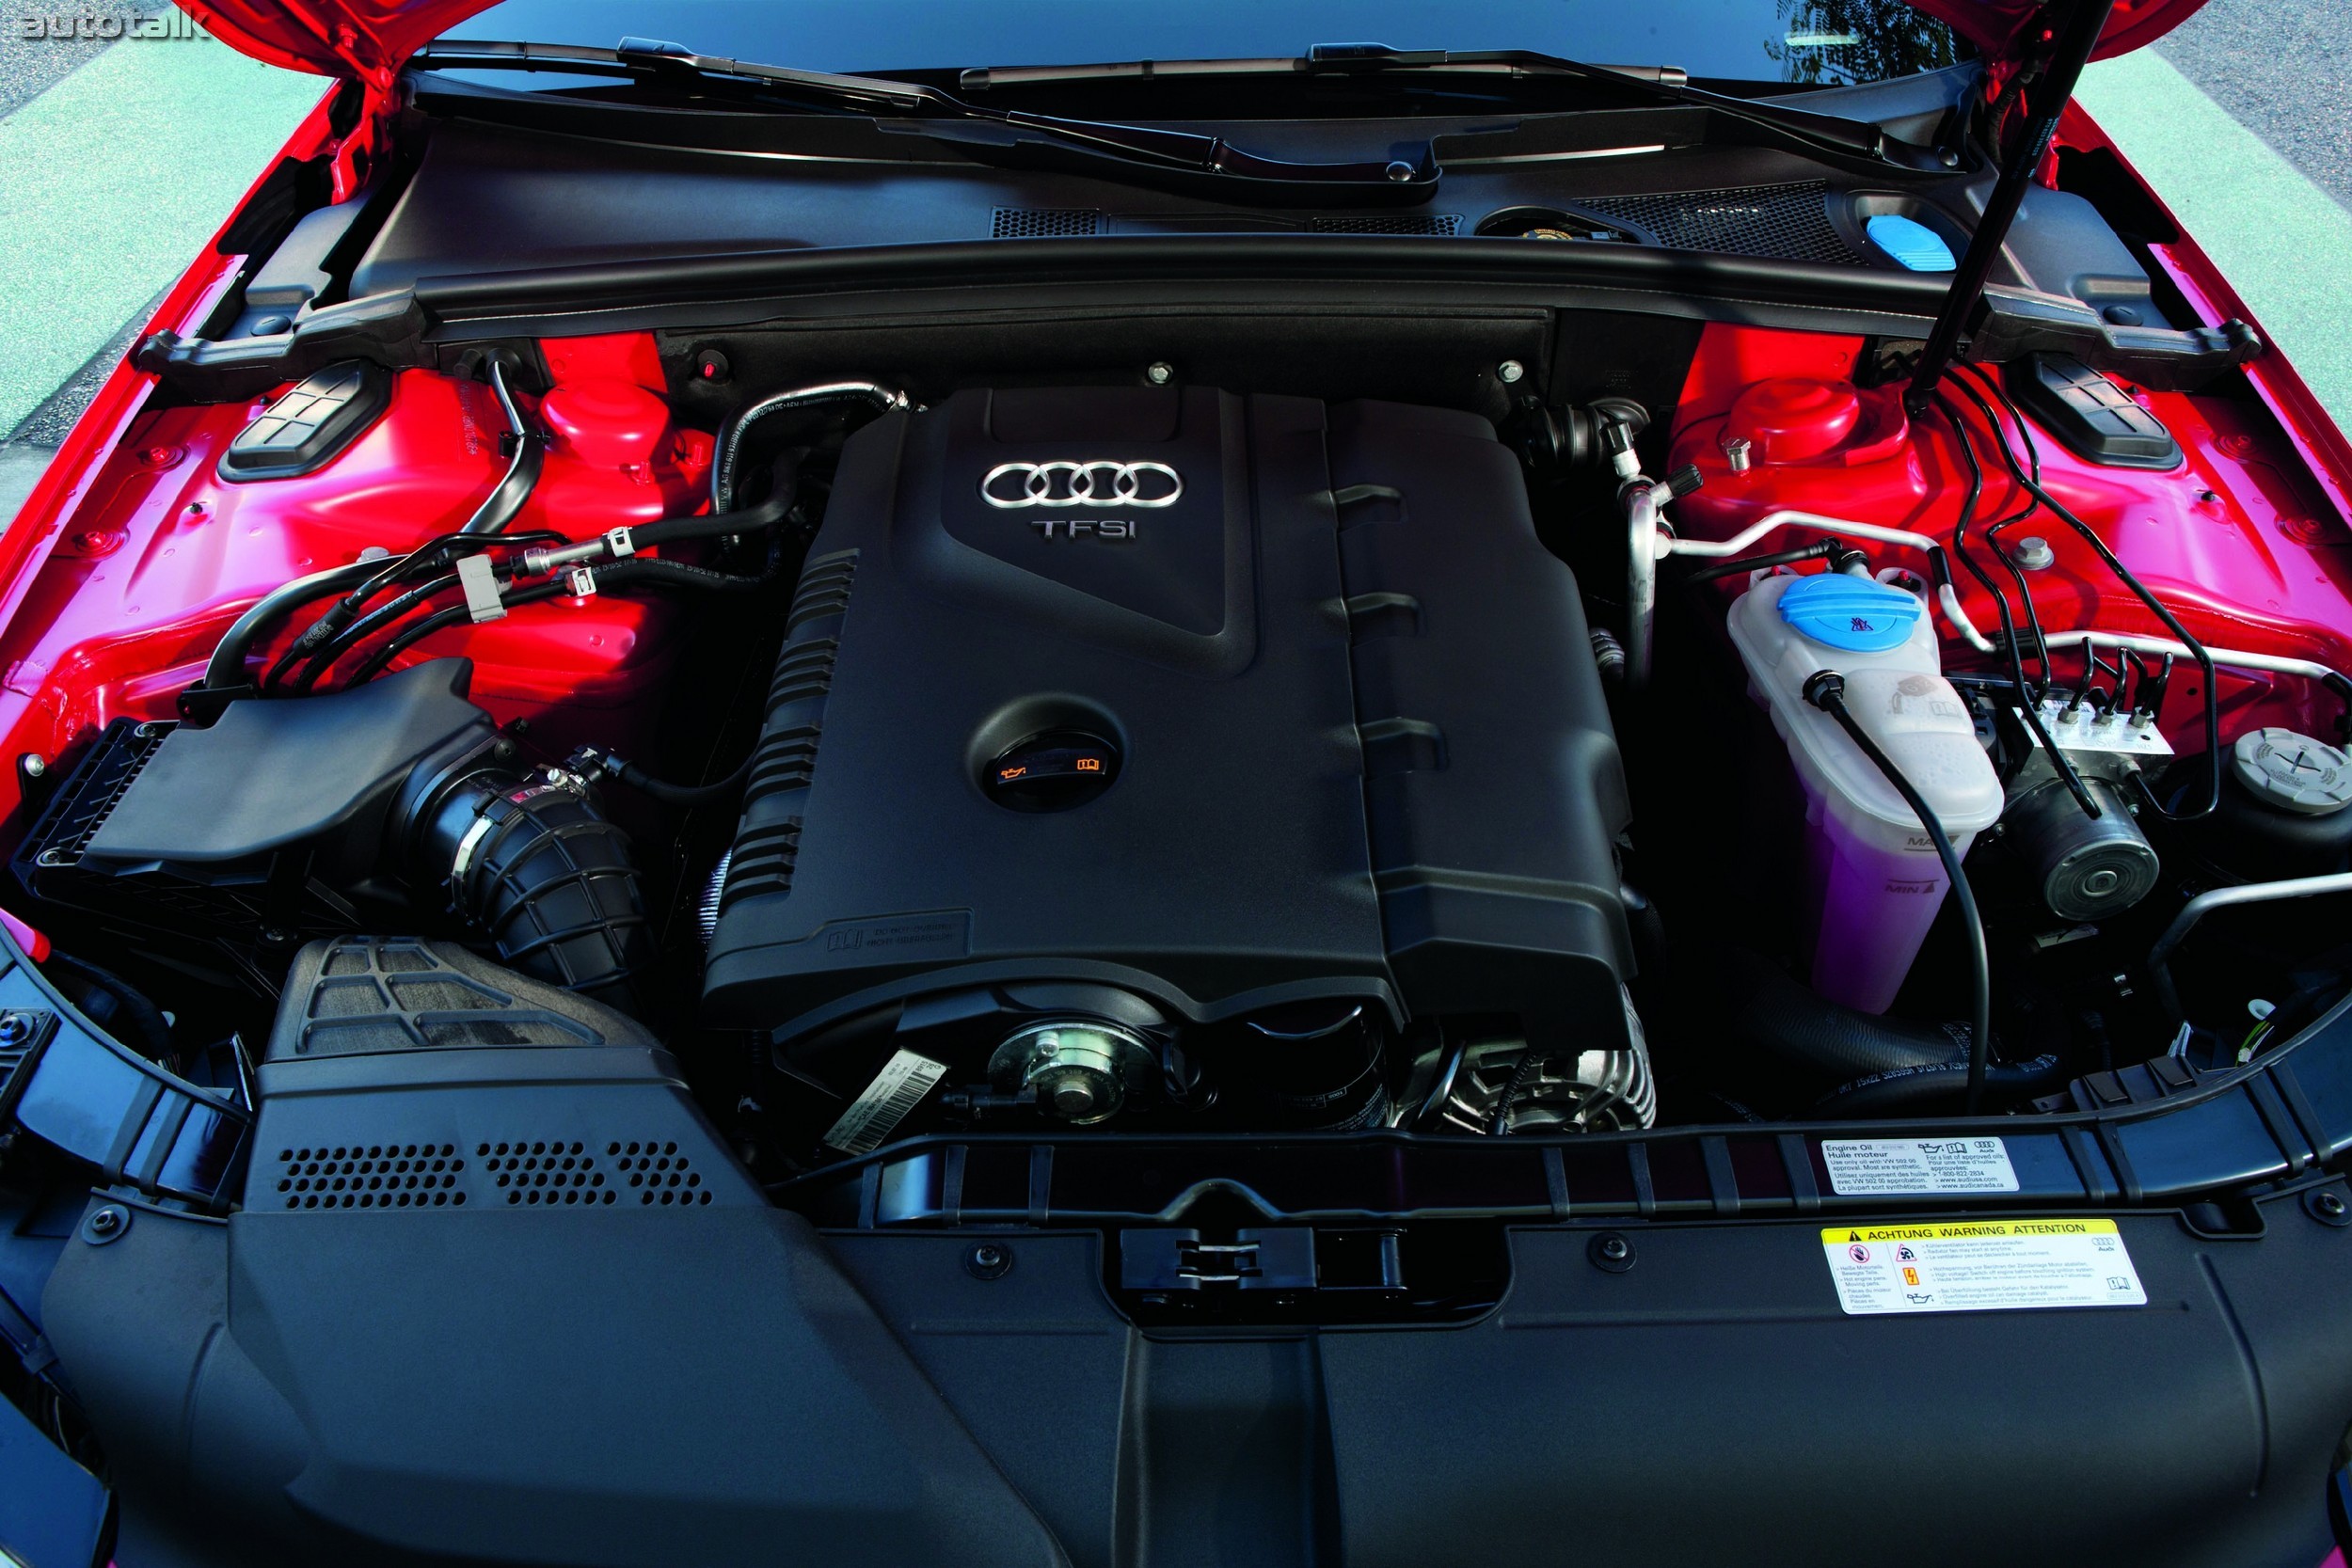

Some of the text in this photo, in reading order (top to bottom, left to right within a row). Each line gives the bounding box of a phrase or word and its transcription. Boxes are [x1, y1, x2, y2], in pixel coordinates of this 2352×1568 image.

[1031, 520, 1136, 541] TFSI
[1907, 837, 1934, 846] MA
[1885, 884, 1920, 894] MIN
[1868, 1223, 2087, 1240] ACHTUNG WARNING ATTENTION
